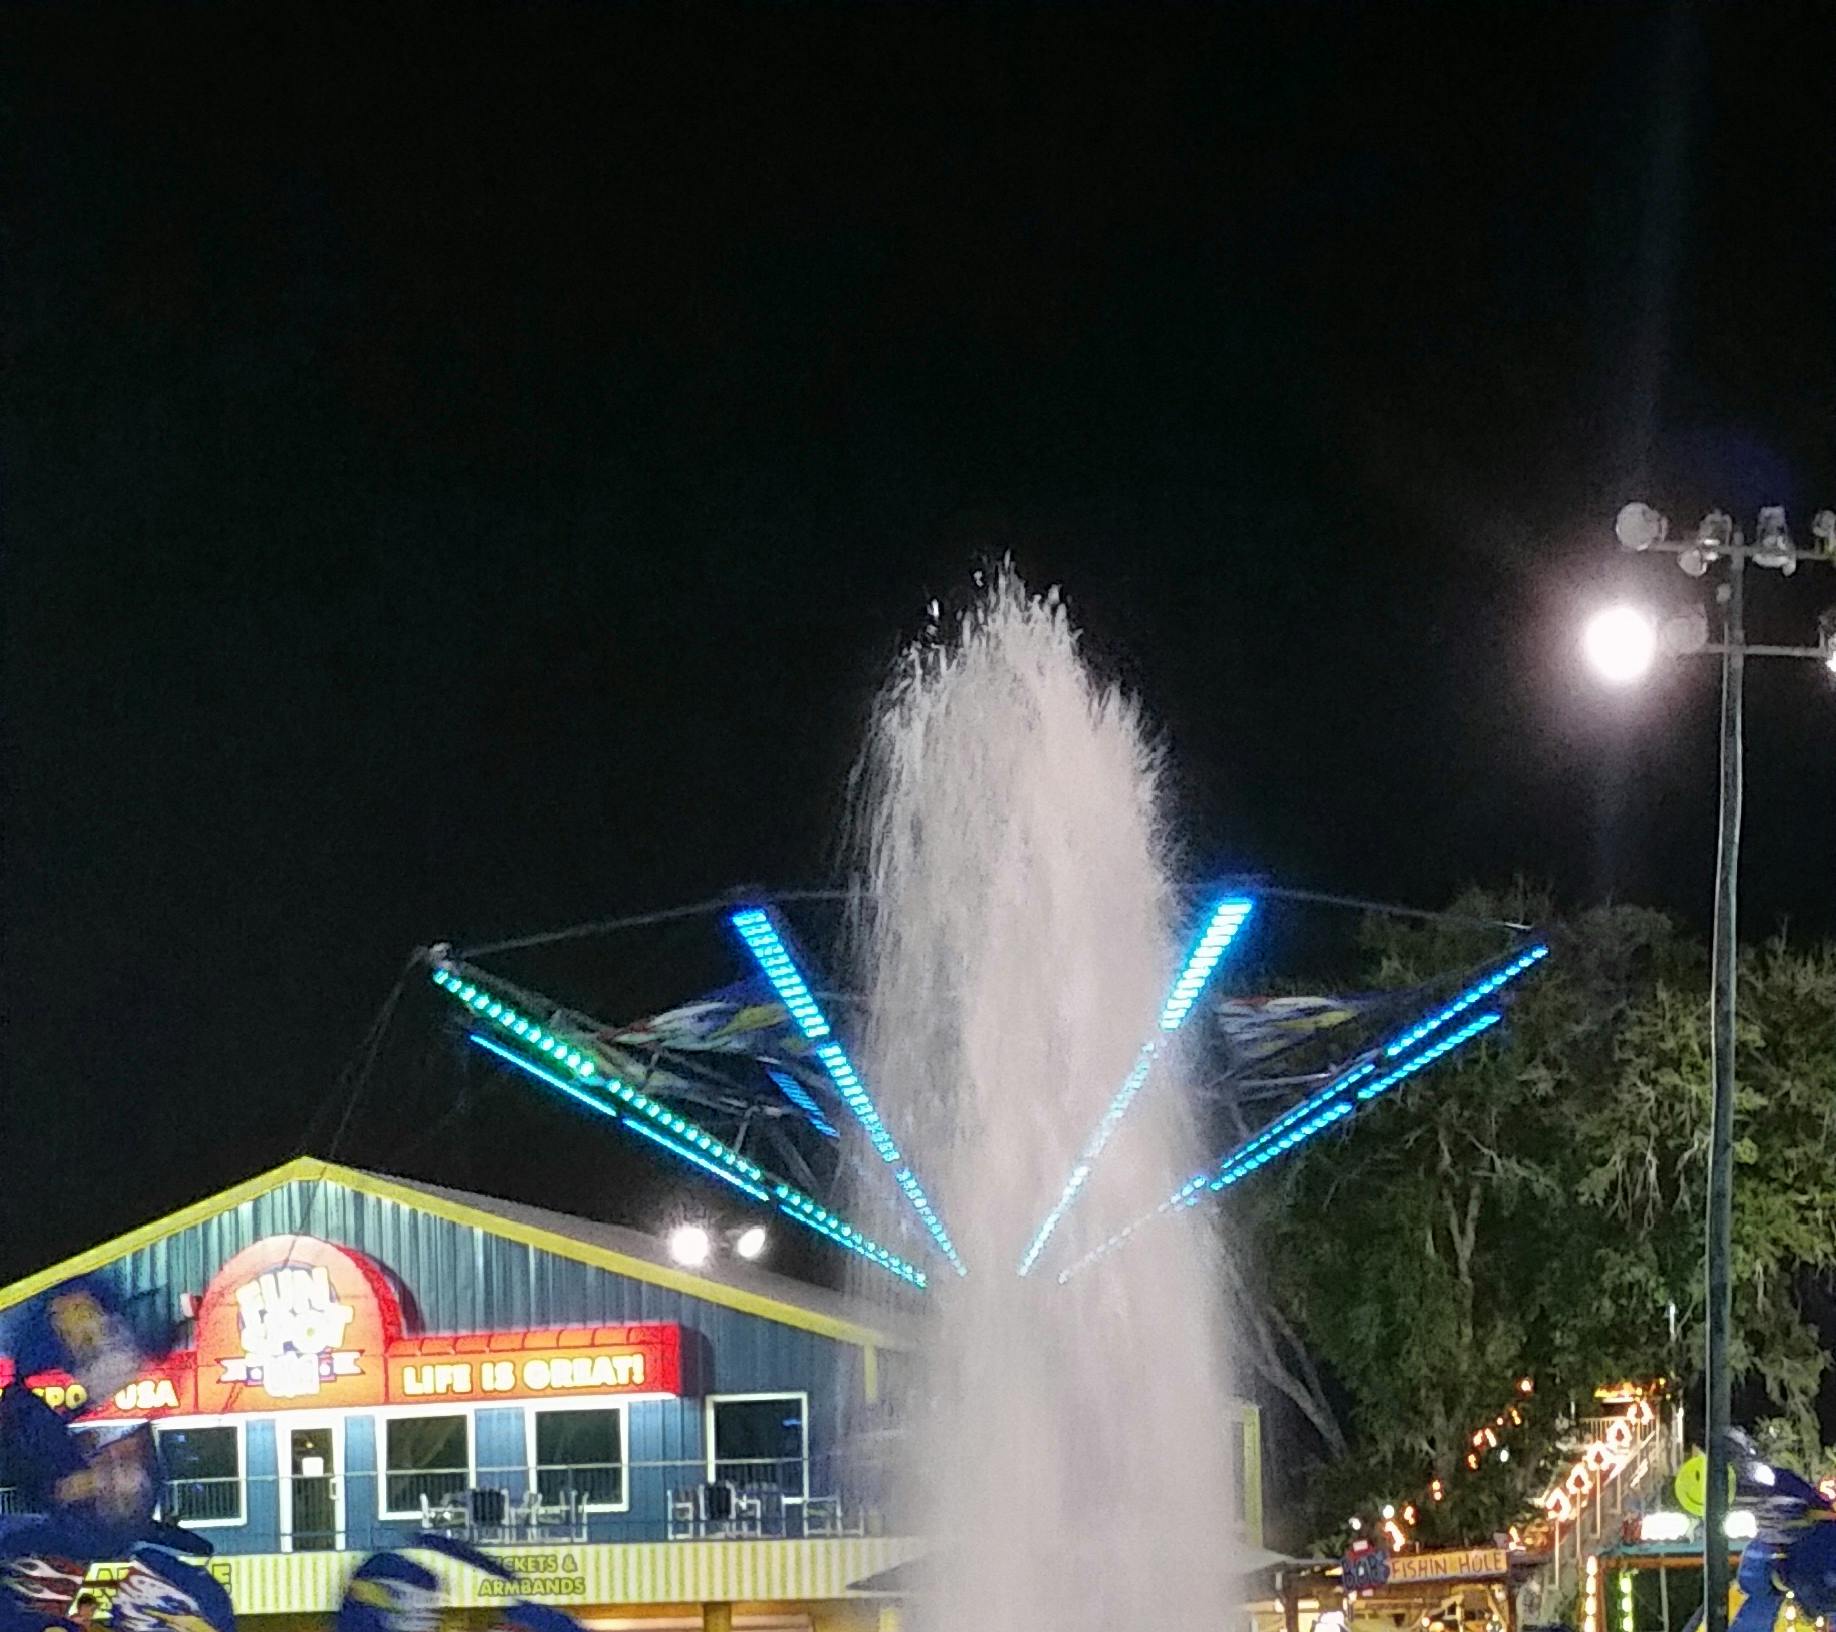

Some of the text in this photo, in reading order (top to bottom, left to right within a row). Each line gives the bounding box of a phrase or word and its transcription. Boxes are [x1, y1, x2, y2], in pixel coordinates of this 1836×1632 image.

[236, 1266, 336, 1324] FUN
[402, 1352, 645, 1396] LIFE IS GREAT!
[114, 1379, 180, 1411] USA
[562, 1552, 578, 1574] &
[1391, 1558, 1448, 1578] FISHIN
[1458, 1551, 1502, 1573] HOLE
[478, 1576, 587, 1597] ARMBANDS
